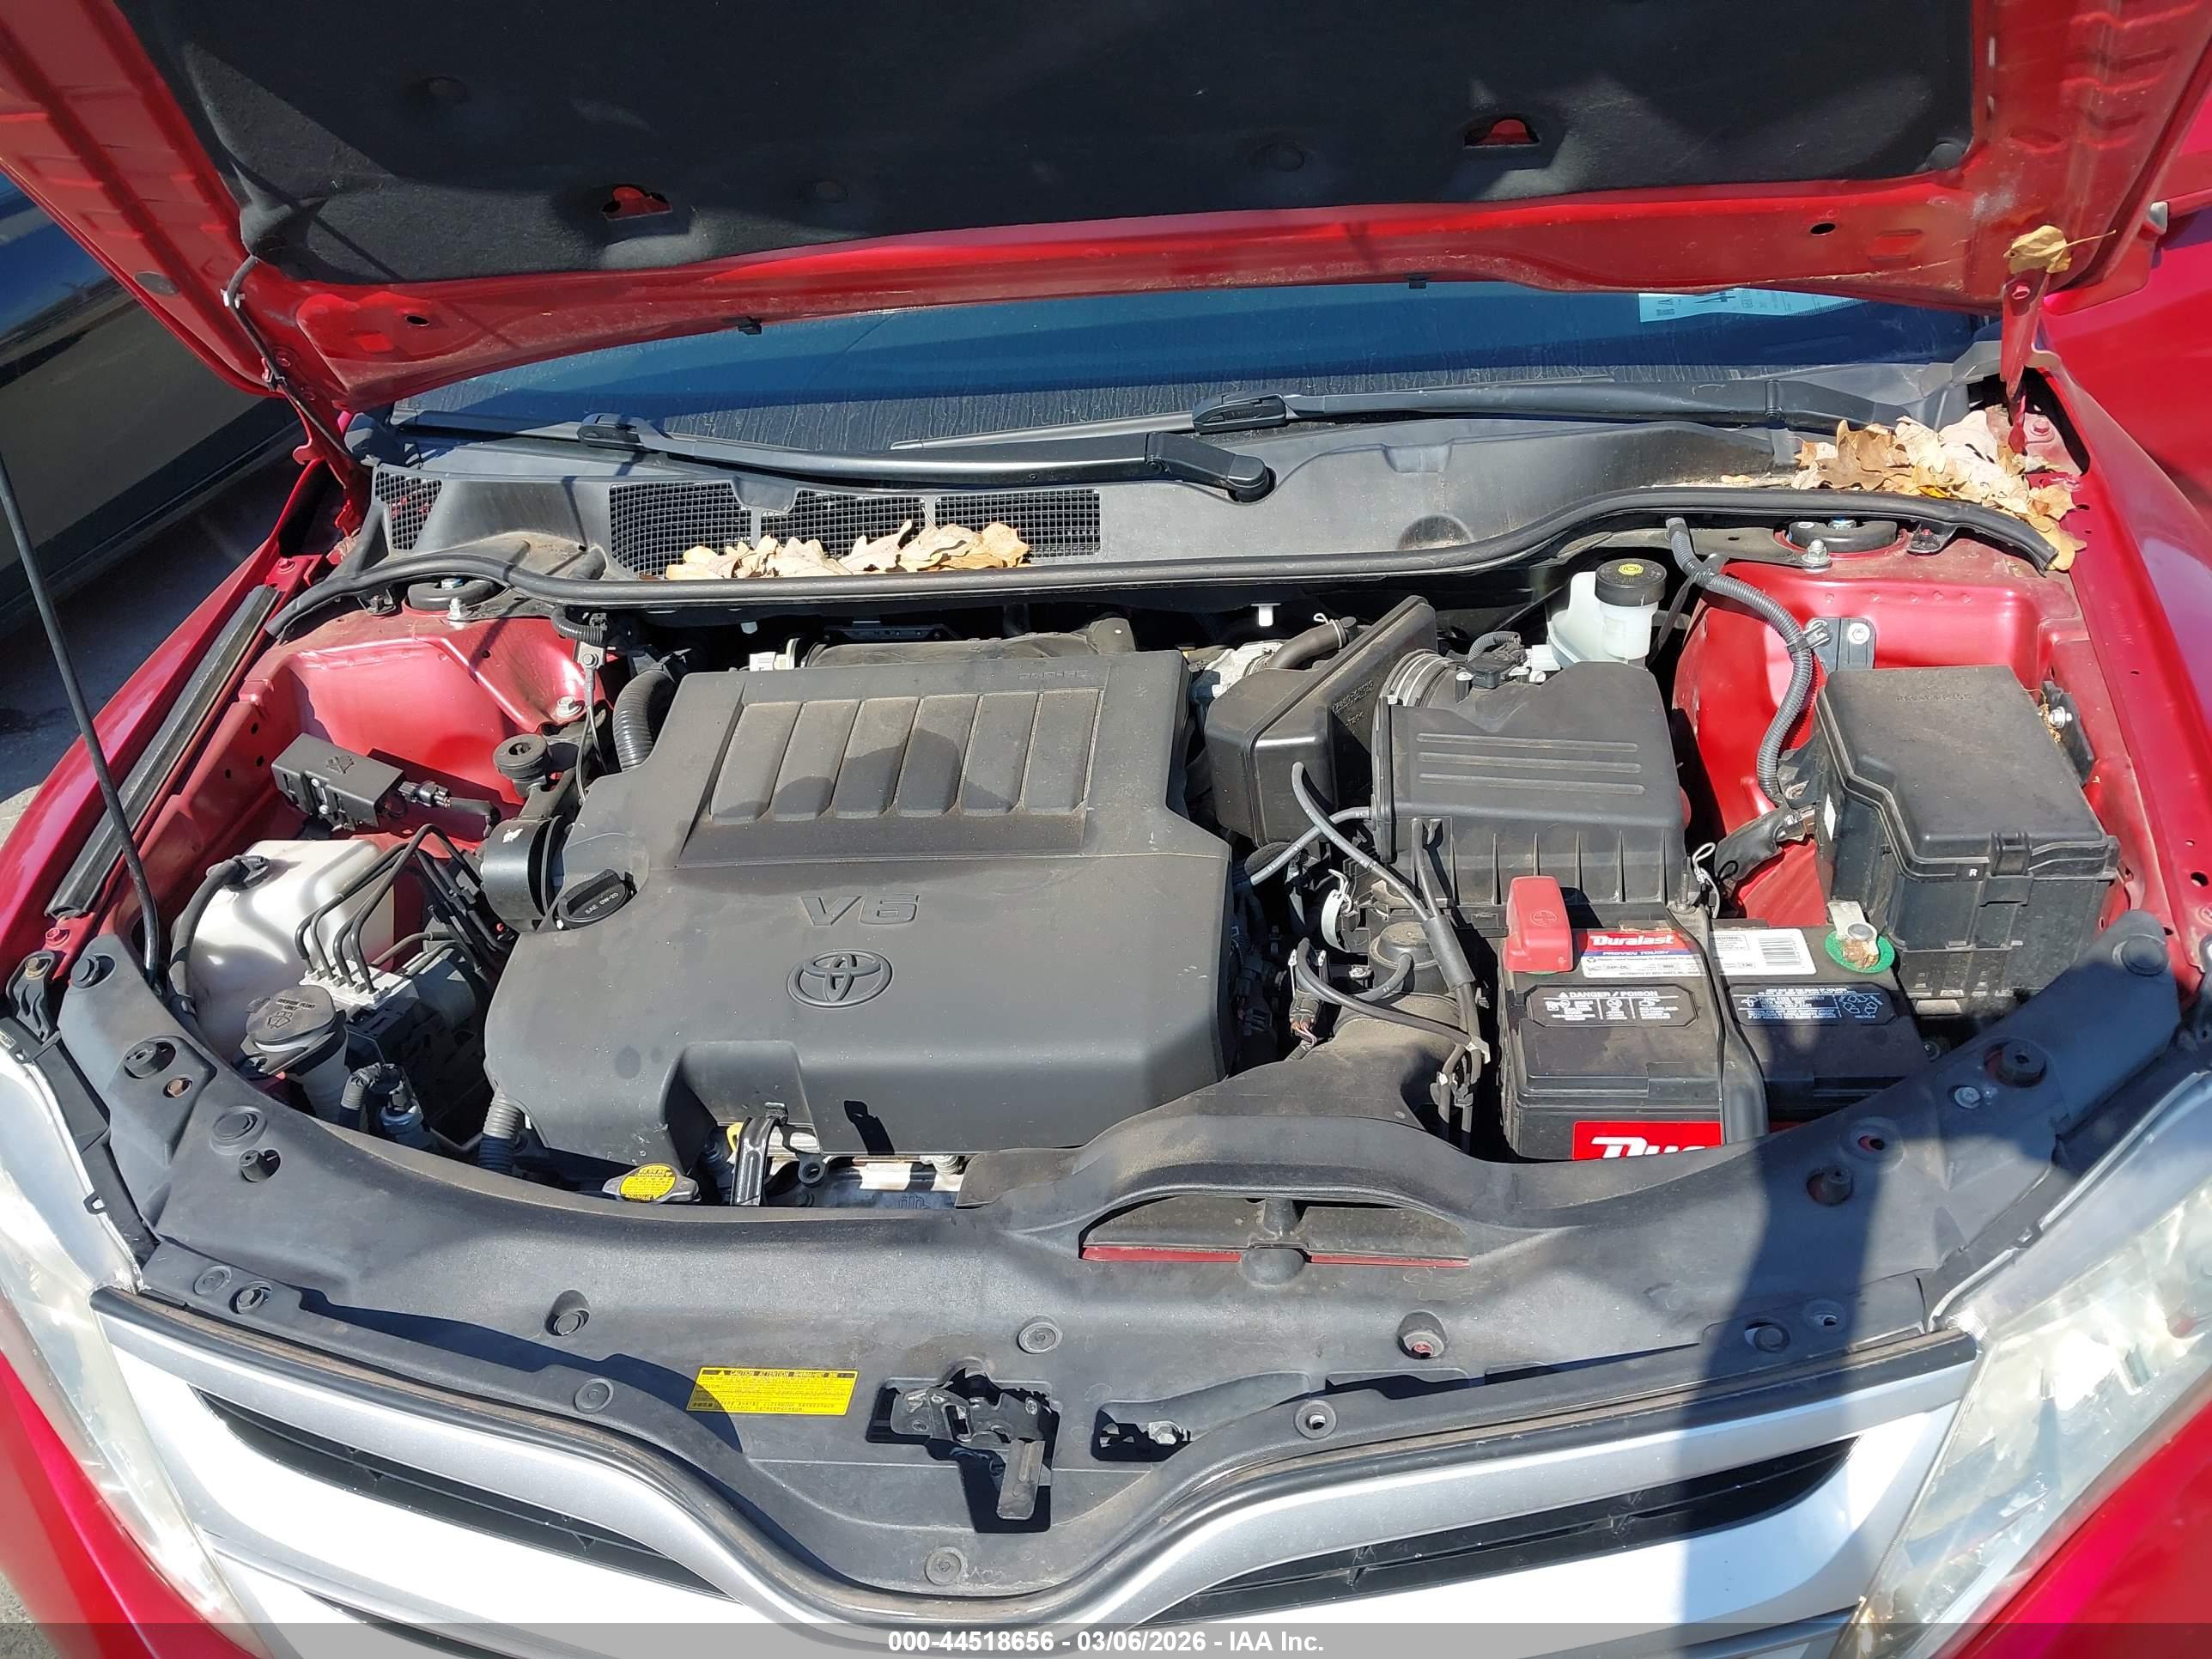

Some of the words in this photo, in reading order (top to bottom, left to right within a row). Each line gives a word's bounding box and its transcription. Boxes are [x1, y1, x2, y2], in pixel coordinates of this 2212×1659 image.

[1969, 868, 1978, 877] R
[585, 904, 599, 915] SAE
[798, 893, 920, 927] V6
[1589, 934, 1674, 946] Duralast
